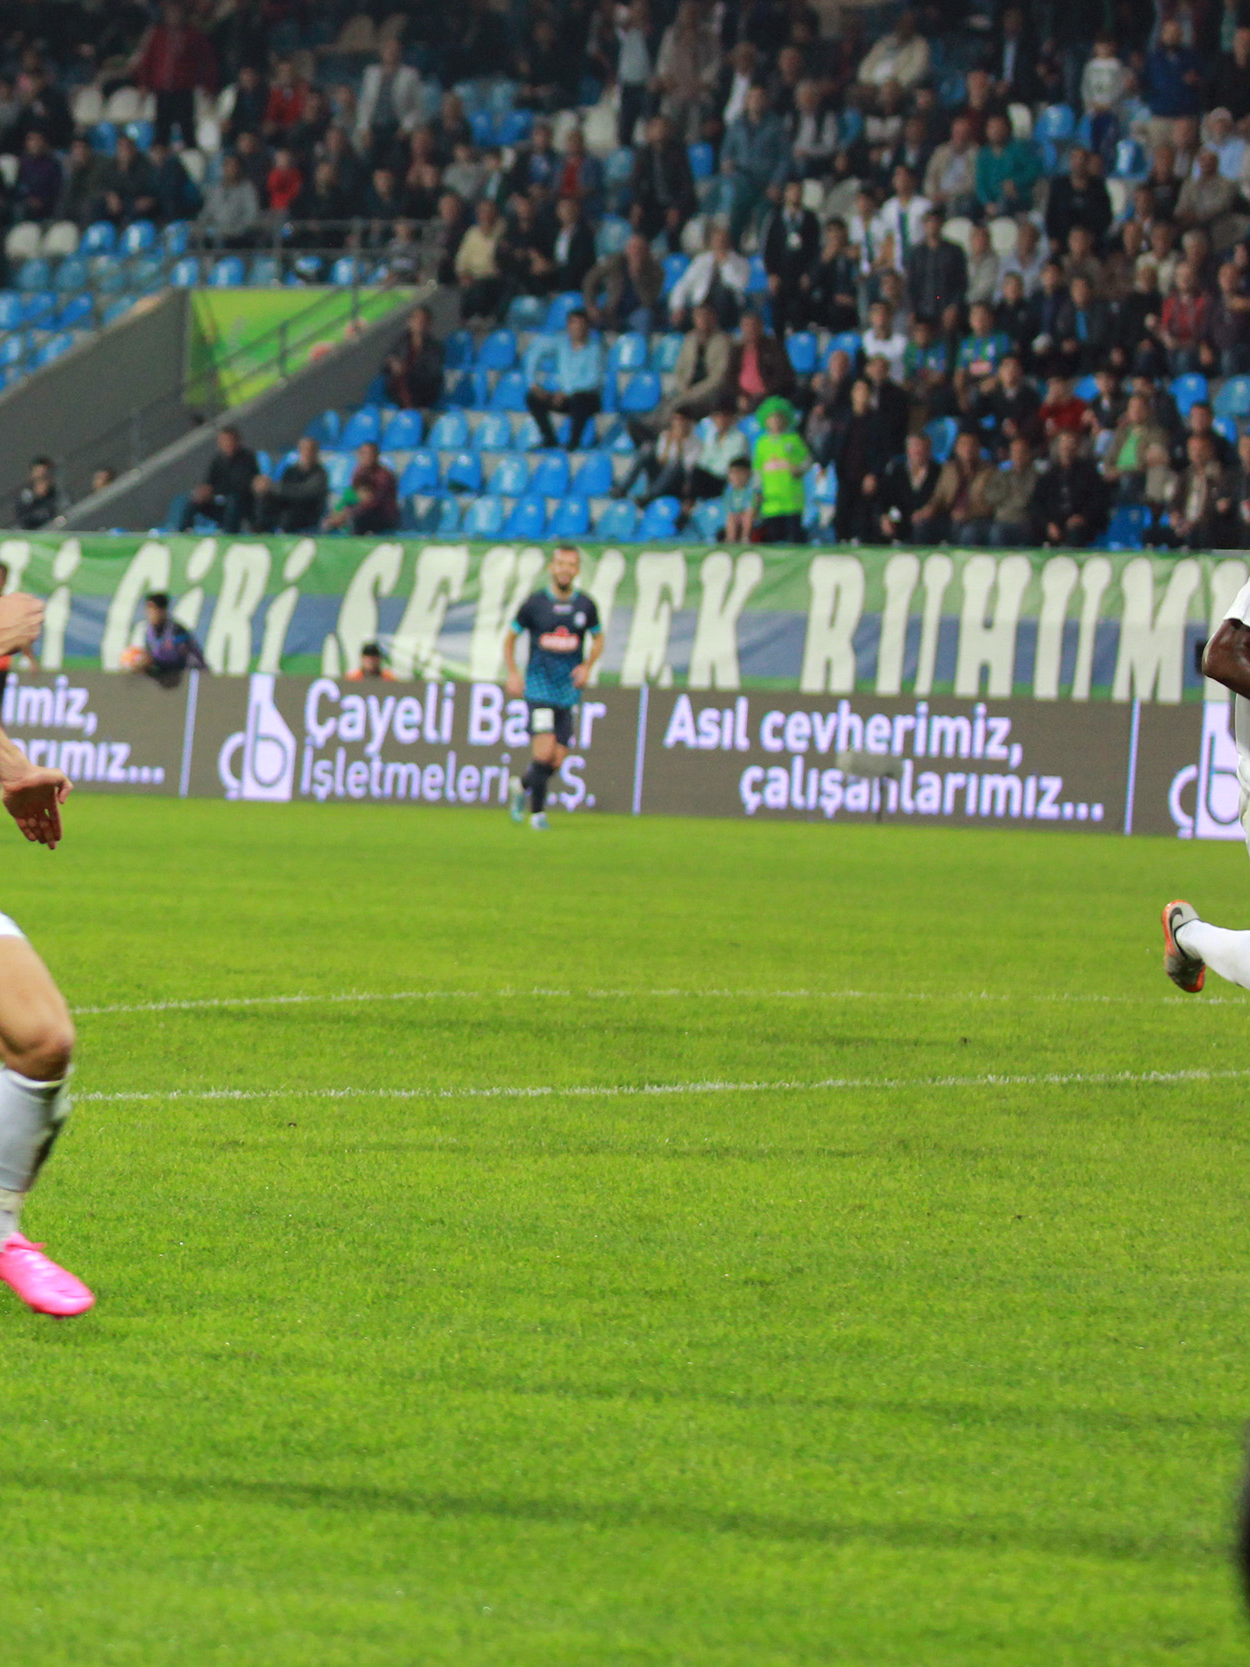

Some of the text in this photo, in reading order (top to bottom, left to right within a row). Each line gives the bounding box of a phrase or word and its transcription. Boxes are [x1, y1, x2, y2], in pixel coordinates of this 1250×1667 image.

[305, 678, 607, 757] Çayeli Bar
[663, 694, 1024, 770] Asıl cevherimiz,
[528, 754, 597, 813] .Ş.
[739, 754, 1105, 822] çalışanlarımız...
